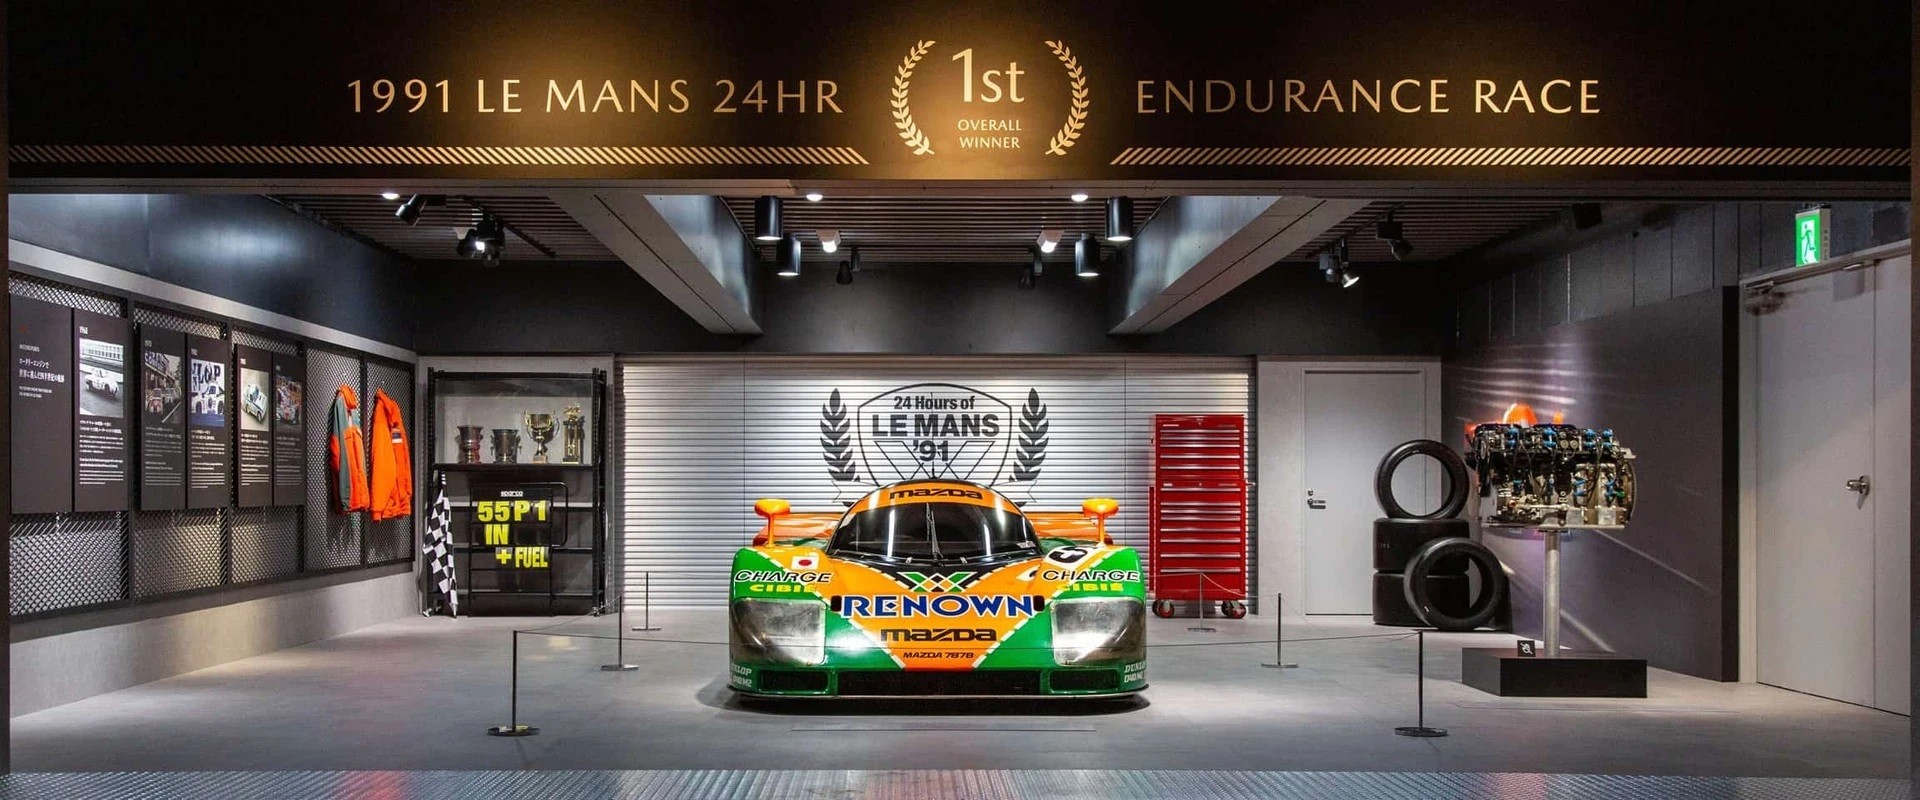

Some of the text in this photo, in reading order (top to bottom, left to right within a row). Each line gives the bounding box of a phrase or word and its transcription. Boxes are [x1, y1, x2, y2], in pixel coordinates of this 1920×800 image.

[952, 48, 1025, 103] 1st
[348, 78, 844, 114] 1991 LE MANS 24HR
[1137, 79, 1600, 114] ENDURANCE RACE
[957, 119, 1022, 131] OVERALL
[959, 136, 1021, 149] WINNER
[893, 395, 976, 410] 24 Hours of
[872, 414, 1000, 437] LE MANS
[912, 440, 949, 461] '91
[889, 488, 983, 500] mazda
[478, 501, 510, 522] 55
[485, 524, 510, 545] IN
[514, 546, 548, 568] FUEL
[734, 569, 833, 583] CHARGE
[1042, 569, 1140, 582] CHARGE
[749, 583, 818, 593] CIBIE
[841, 594, 1036, 618] RENOWN
[880, 628, 997, 642] mazda
[903, 651, 942, 659] MAZDA
